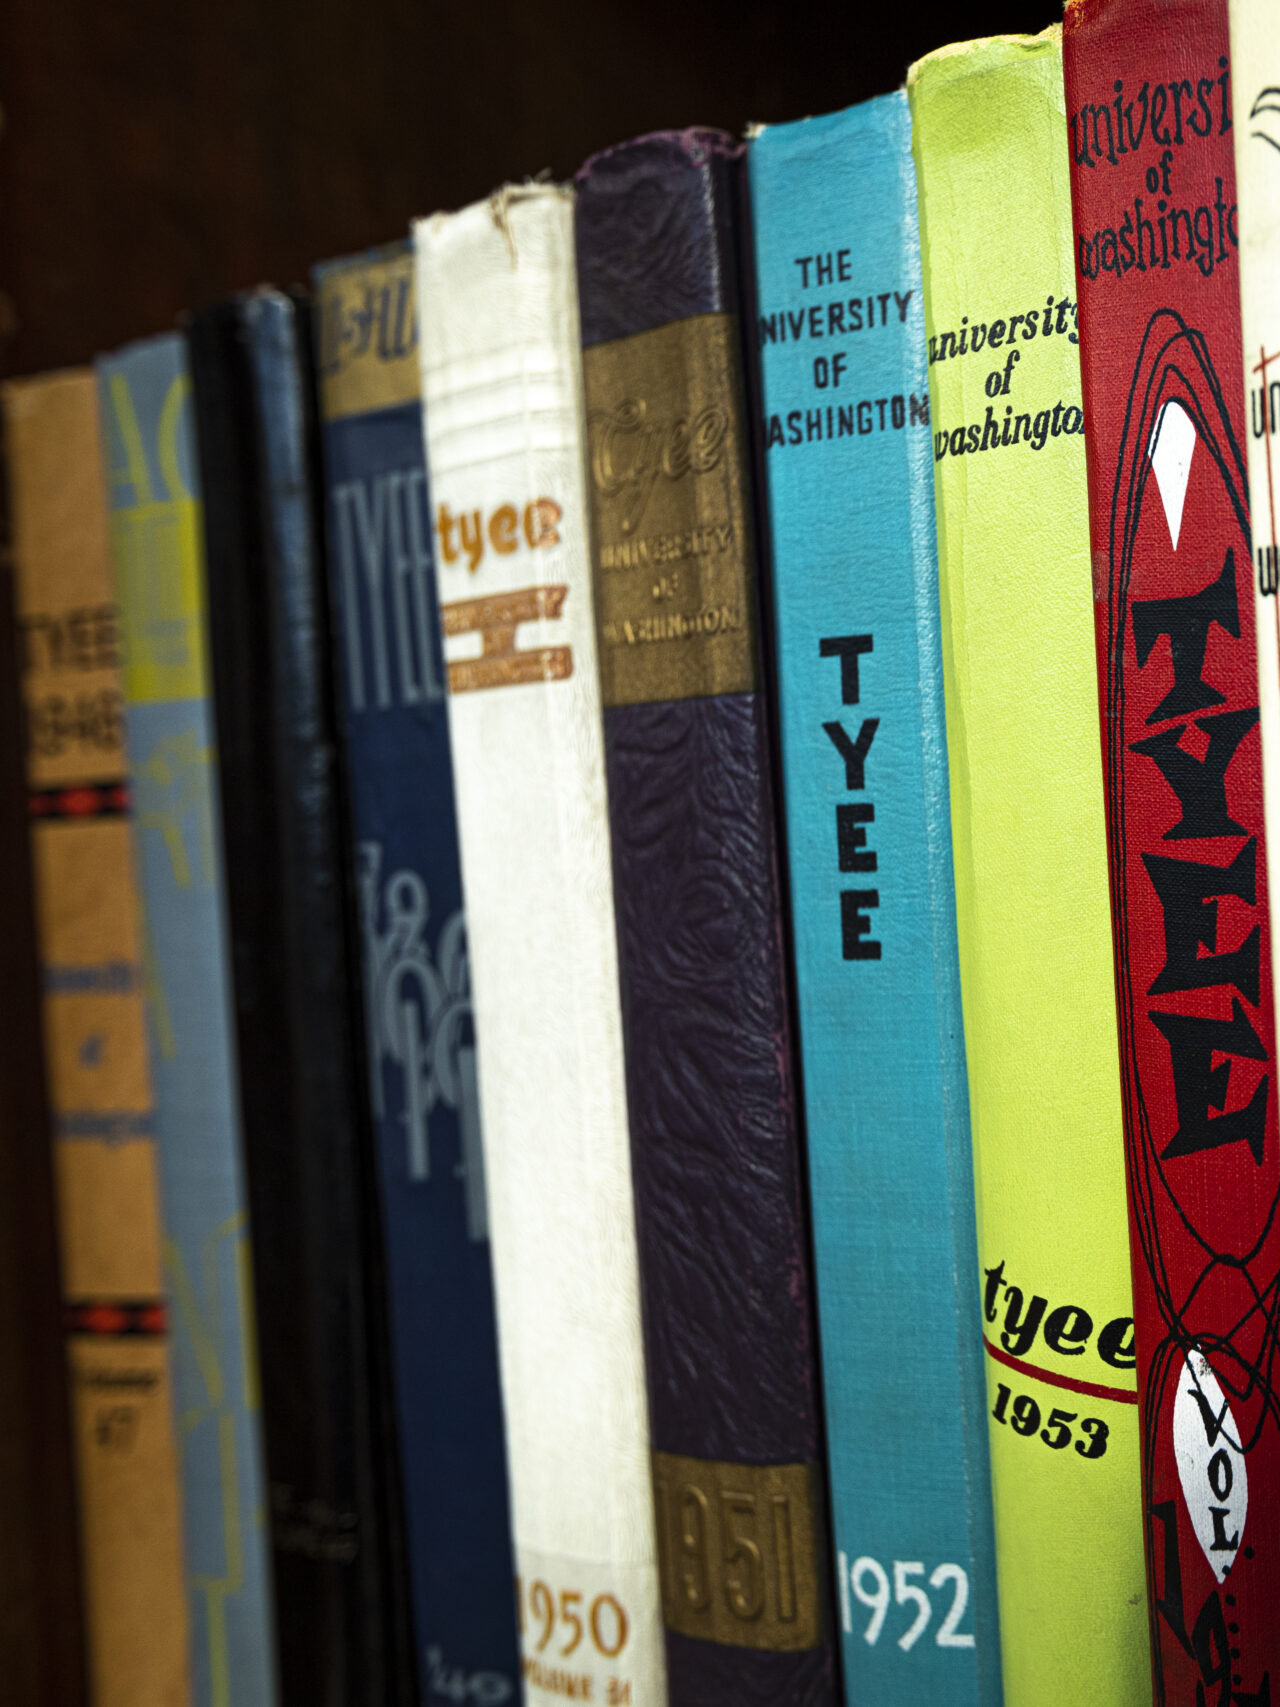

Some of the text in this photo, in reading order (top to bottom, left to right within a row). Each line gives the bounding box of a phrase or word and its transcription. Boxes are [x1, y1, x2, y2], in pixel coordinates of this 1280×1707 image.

[1070, 56, 1232, 167] universi
[1146, 150, 1173, 196] of
[794, 250, 852, 289] THE
[758, 290, 914, 346] NIVERSITY
[813, 352, 847, 389] OF
[984, 350, 1020, 398] of
[765, 392, 930, 450] ASHINGTON
[934, 400, 1085, 462] washingto
[818, 634, 882, 961] TYEE
[1128, 546, 1269, 1166] TYEE
[984, 1260, 1136, 1369] tyee
[992, 1382, 1109, 1459] 1953
[838, 1550, 975, 1652] 1952
